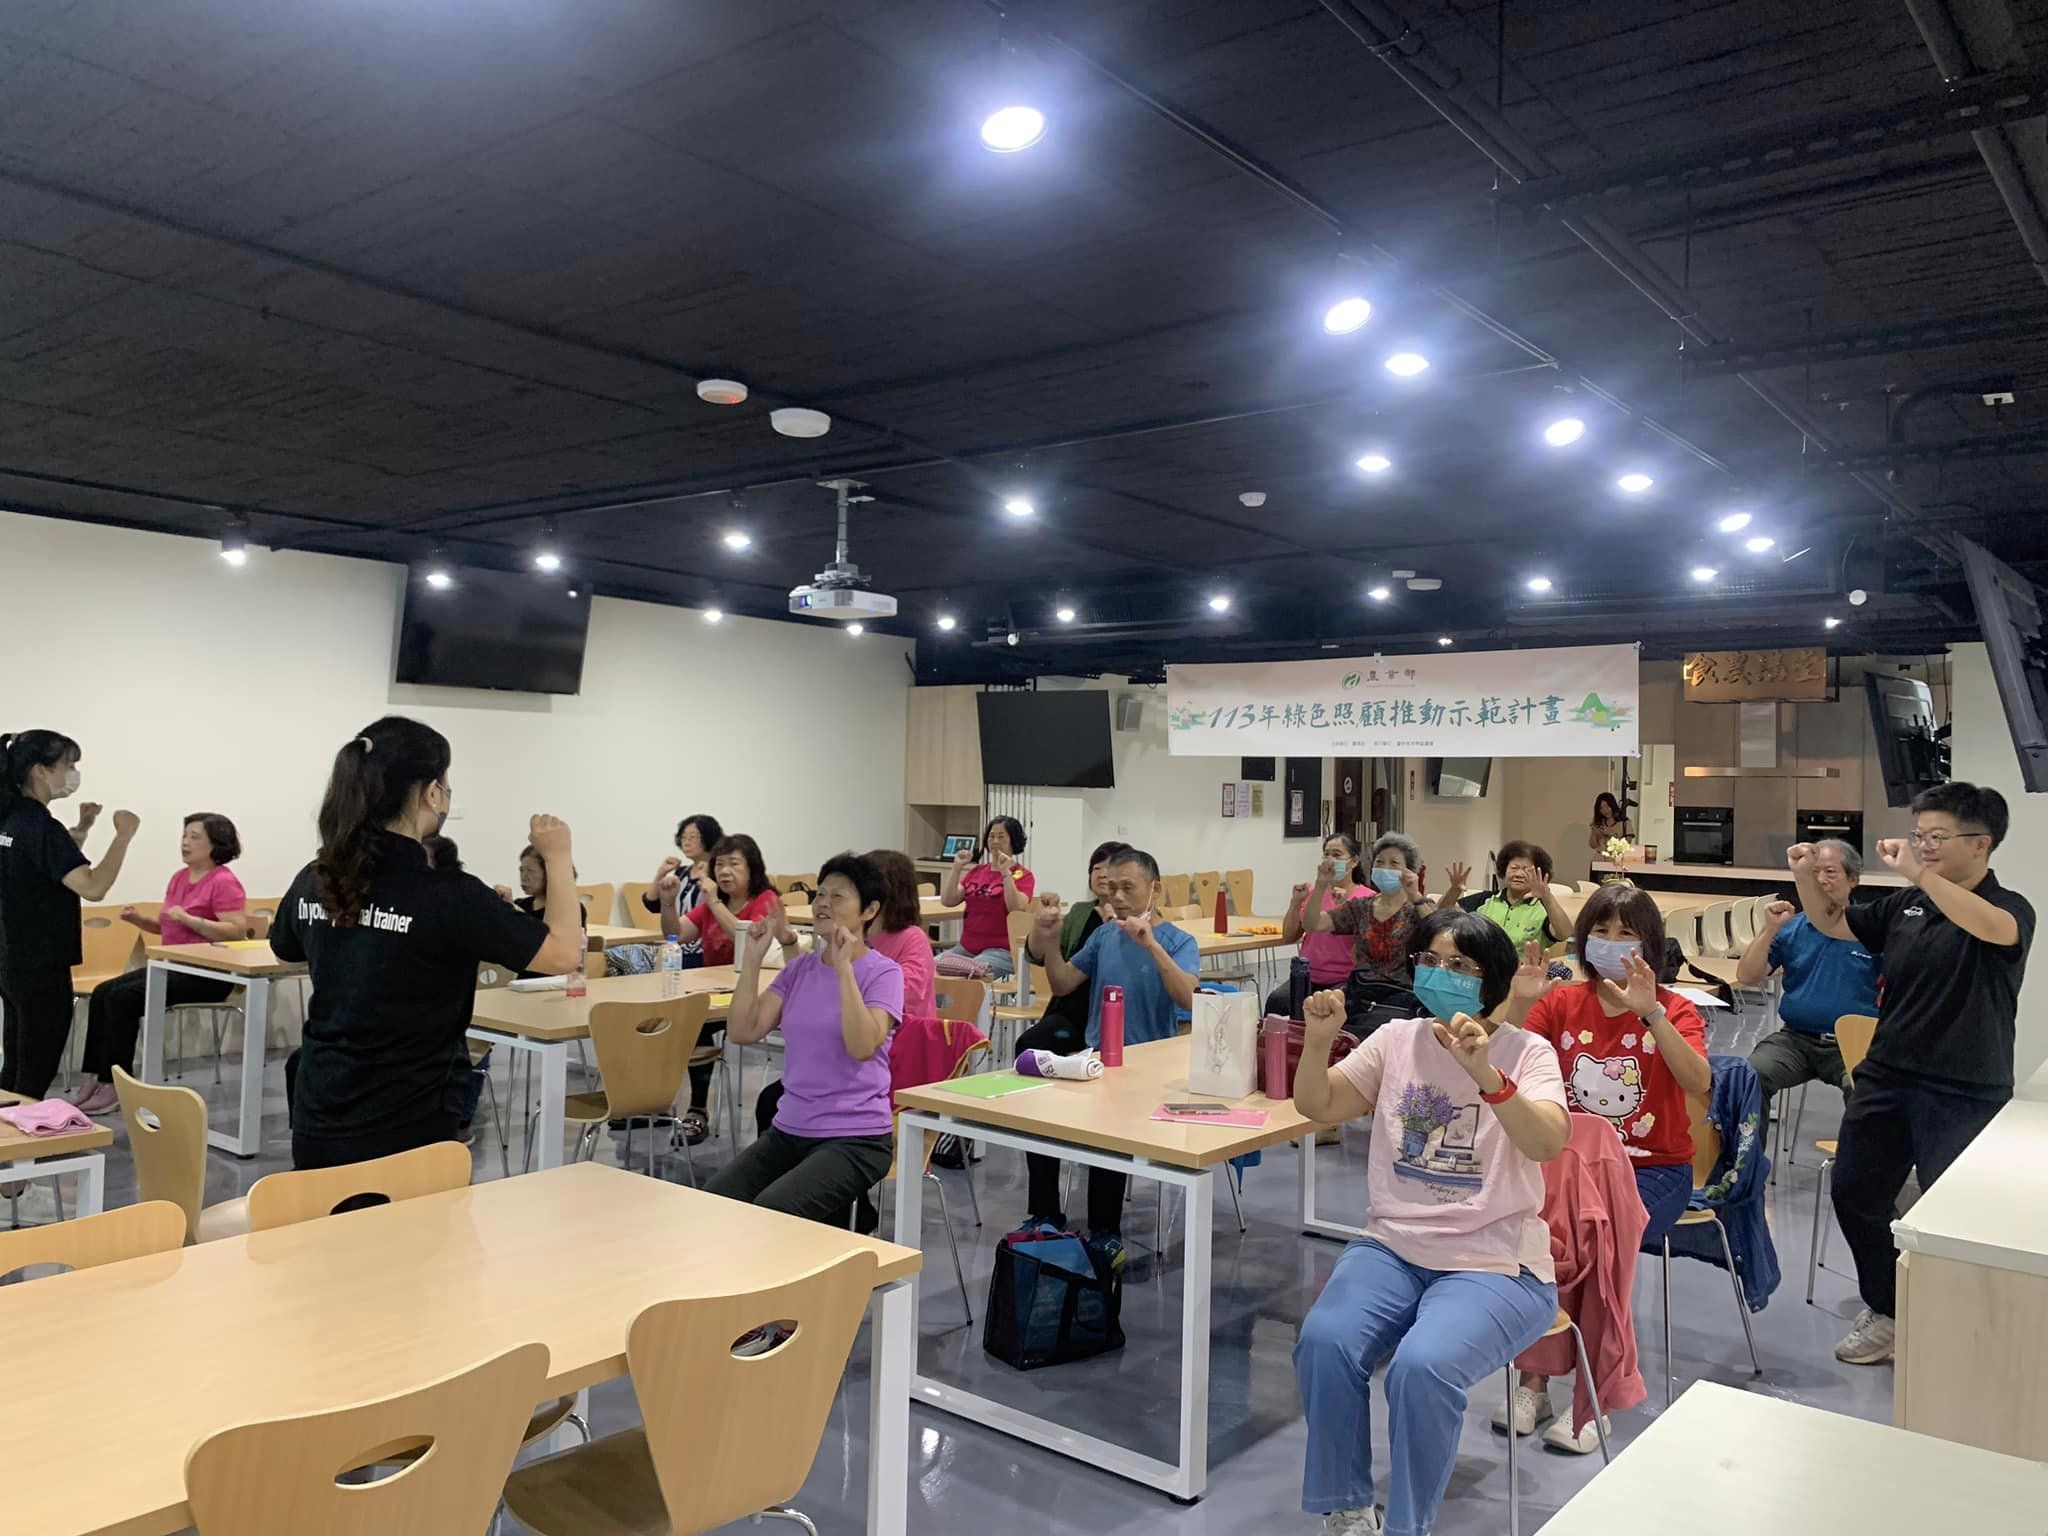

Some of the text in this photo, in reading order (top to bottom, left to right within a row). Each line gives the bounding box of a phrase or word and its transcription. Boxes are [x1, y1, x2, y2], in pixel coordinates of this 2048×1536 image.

[1208, 695, 1565, 731] 113年綠色照顧推動示範計畫
[309, 902, 329, 926] you
[373, 906, 413, 934] trainer
